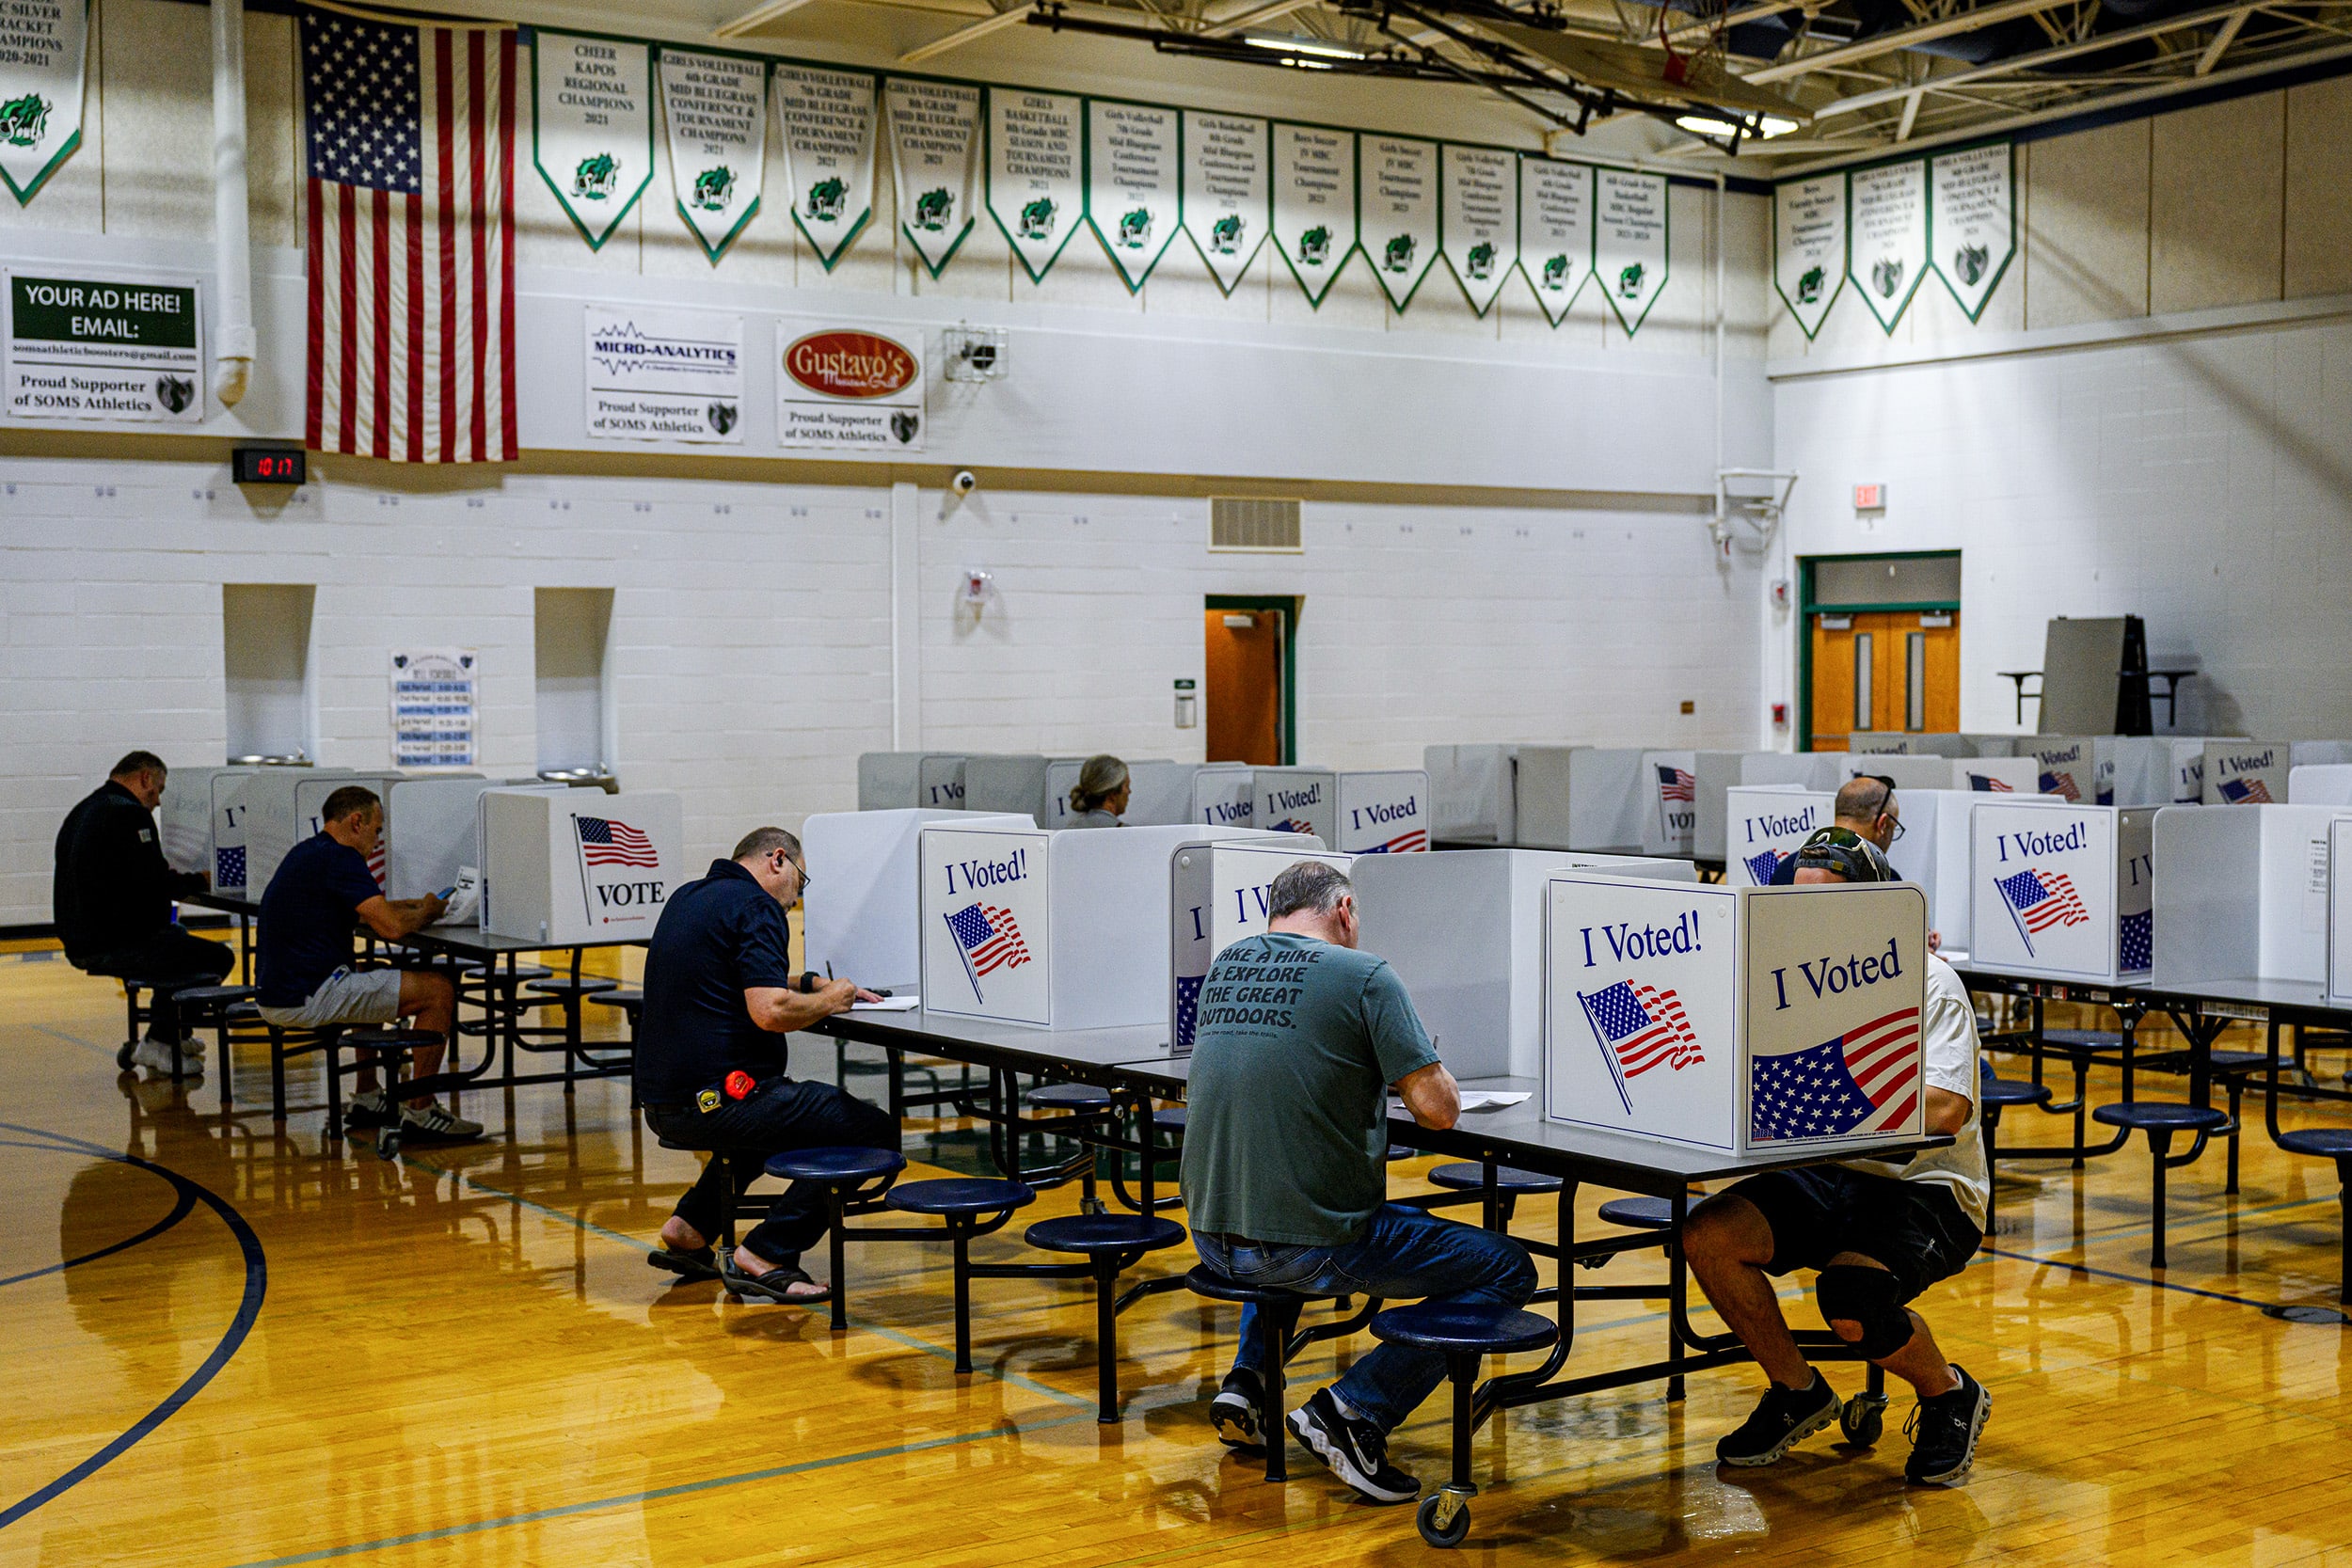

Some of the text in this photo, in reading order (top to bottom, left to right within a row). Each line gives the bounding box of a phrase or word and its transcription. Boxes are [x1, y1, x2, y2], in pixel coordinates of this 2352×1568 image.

[11, 4, 61, 19] SILVER
[574, 44, 617, 60] CHEER
[575, 60, 616, 76] KAPOS
[564, 76, 628, 95] REGIONAL
[558, 92, 635, 112] CHAMPIONS
[680, 126, 747, 144] CHAMPIONS
[24, 285, 181, 313] YOUR AD HERE!
[72, 316, 139, 339] EMAIL:
[595, 341, 736, 361] MICRO-ANALYTICS
[795, 344, 904, 379] Gustavo's
[21, 374, 146, 394] Proud Supporter
[14, 393, 152, 412] of SOMS Athletics
[598, 401, 699, 418] Proud Supporter
[594, 418, 705, 434] of SOMS Athletics
[789, 412, 882, 427] Proud Supporter
[785, 429, 887, 442] of SOMS Athletics
[2218, 758, 2226, 776] I
[2229, 750, 2275, 773] Voted!
[930, 786, 939, 804] I
[1267, 782, 1321, 815] I Voted!
[1352, 796, 1418, 831] I Voted
[1668, 812, 1694, 830] VOT
[1745, 805, 1817, 843] I Voted!
[1997, 821, 2087, 863] I Voted!
[945, 847, 1027, 895] I Voted!
[2129, 858, 2139, 886] I
[596, 881, 665, 908] VOTE
[1234, 889, 1248, 924] I
[1189, 906, 1205, 942] I
[1580, 910, 1702, 967] I Voted!
[1252, 951, 1272, 963] A
[1274, 949, 1325, 963] HIKE
[1208, 966, 1308, 983] & EXPLORE
[1771, 937, 1903, 1011] I Voted
[1205, 986, 1303, 1005] THE GREAT
[1200, 1007, 1296, 1029] OUTDOORS.
